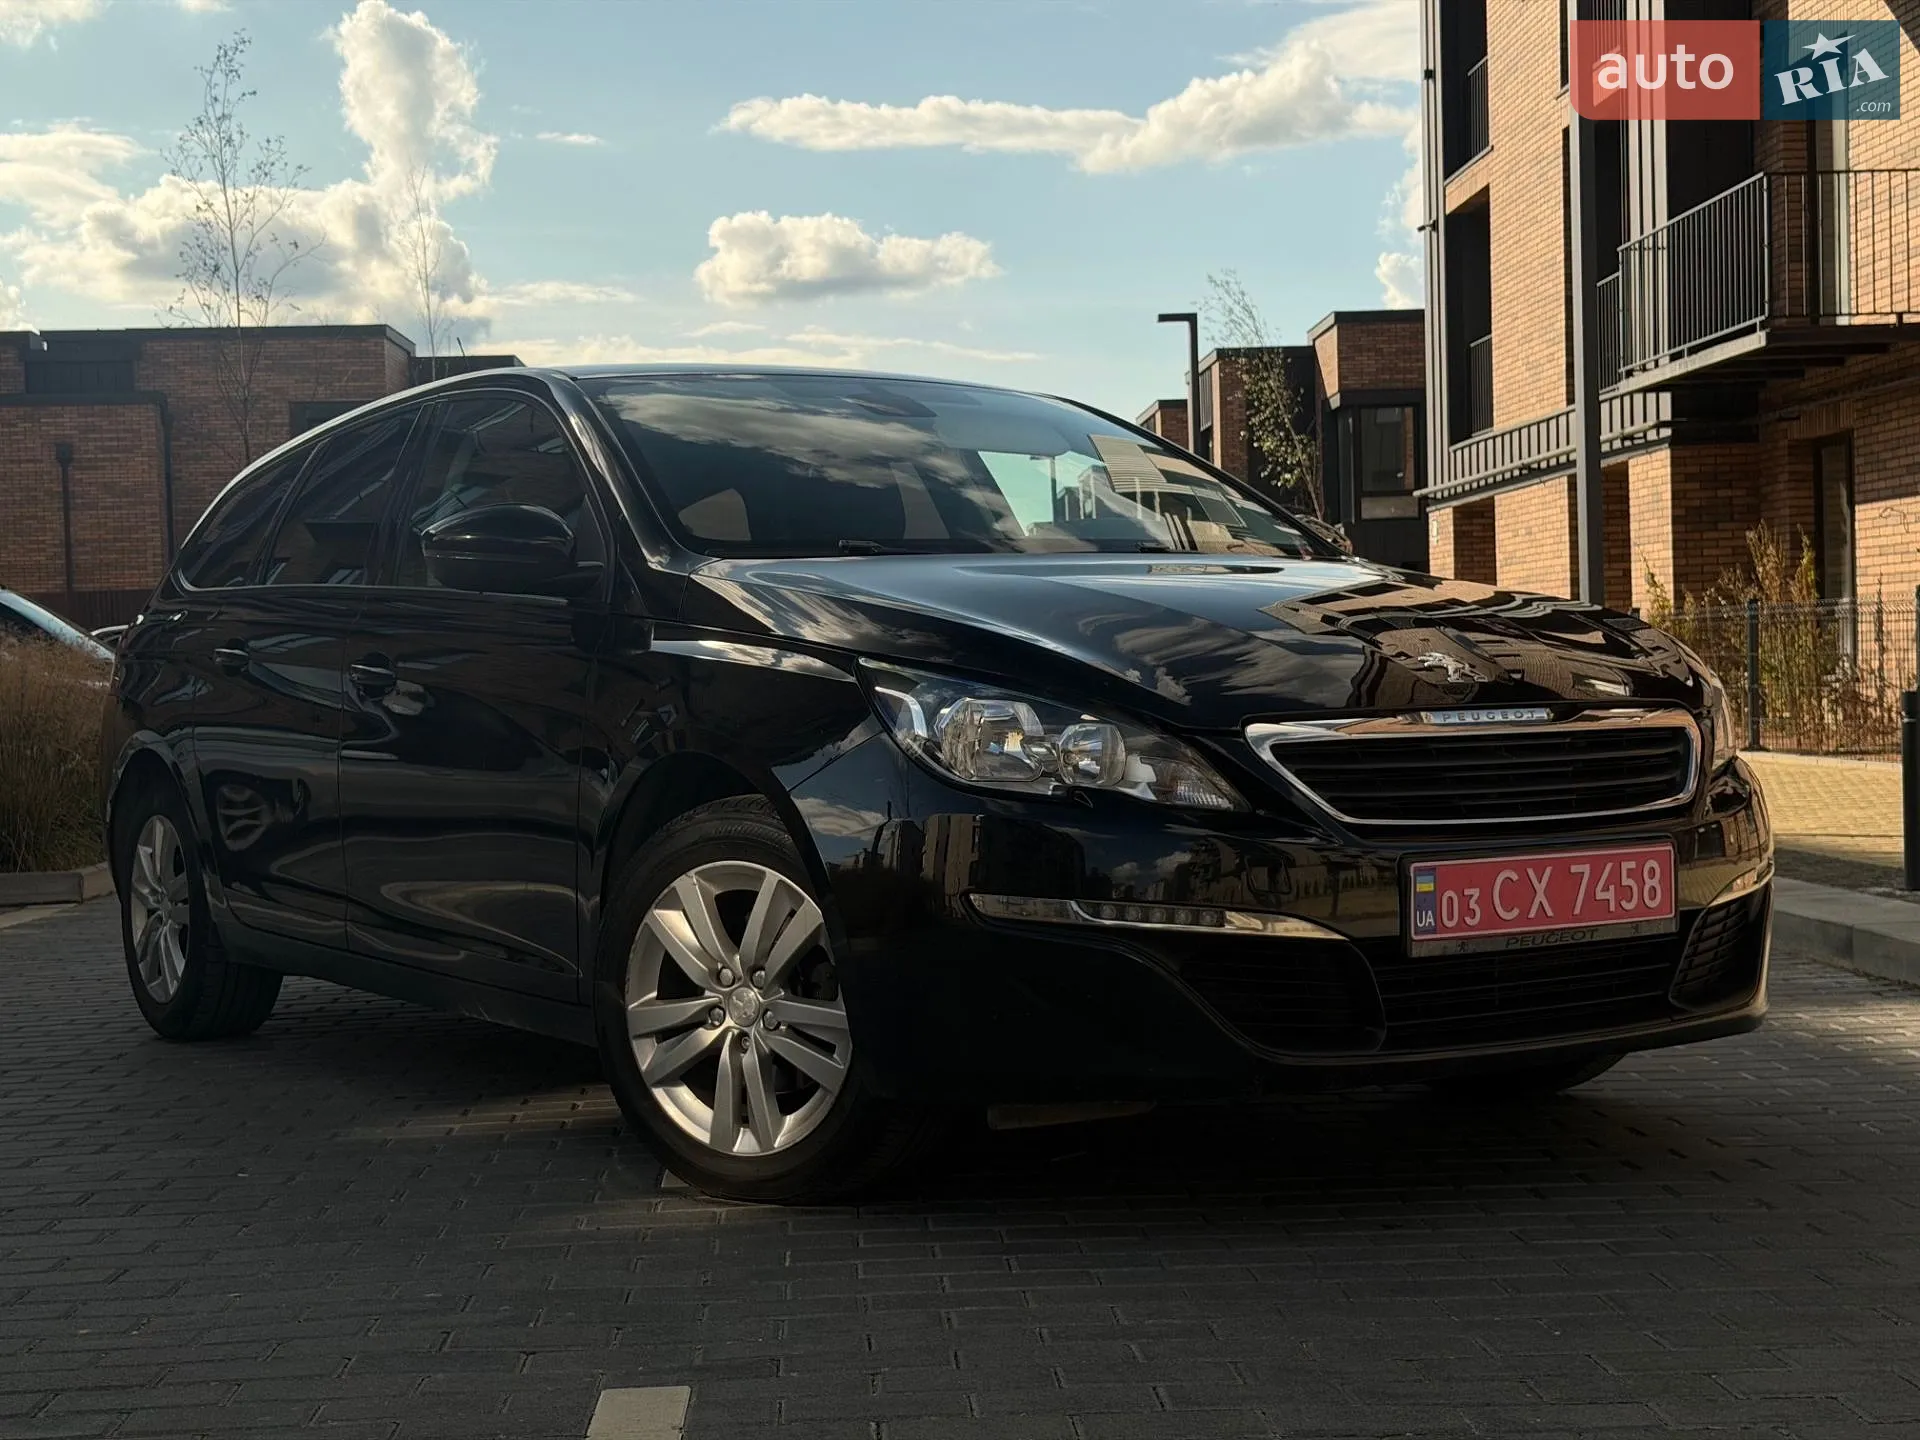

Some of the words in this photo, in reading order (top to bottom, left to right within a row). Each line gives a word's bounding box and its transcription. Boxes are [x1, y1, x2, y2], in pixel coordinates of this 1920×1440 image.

[1442, 709, 1536, 722] PEUGEOT
[1440, 887, 1481, 928] 03
[1492, 866, 1554, 921] CX
[1569, 859, 1661, 917] 7458
[1416, 910, 1435, 928] UA
[1504, 928, 1600, 949] PEUGEOT
